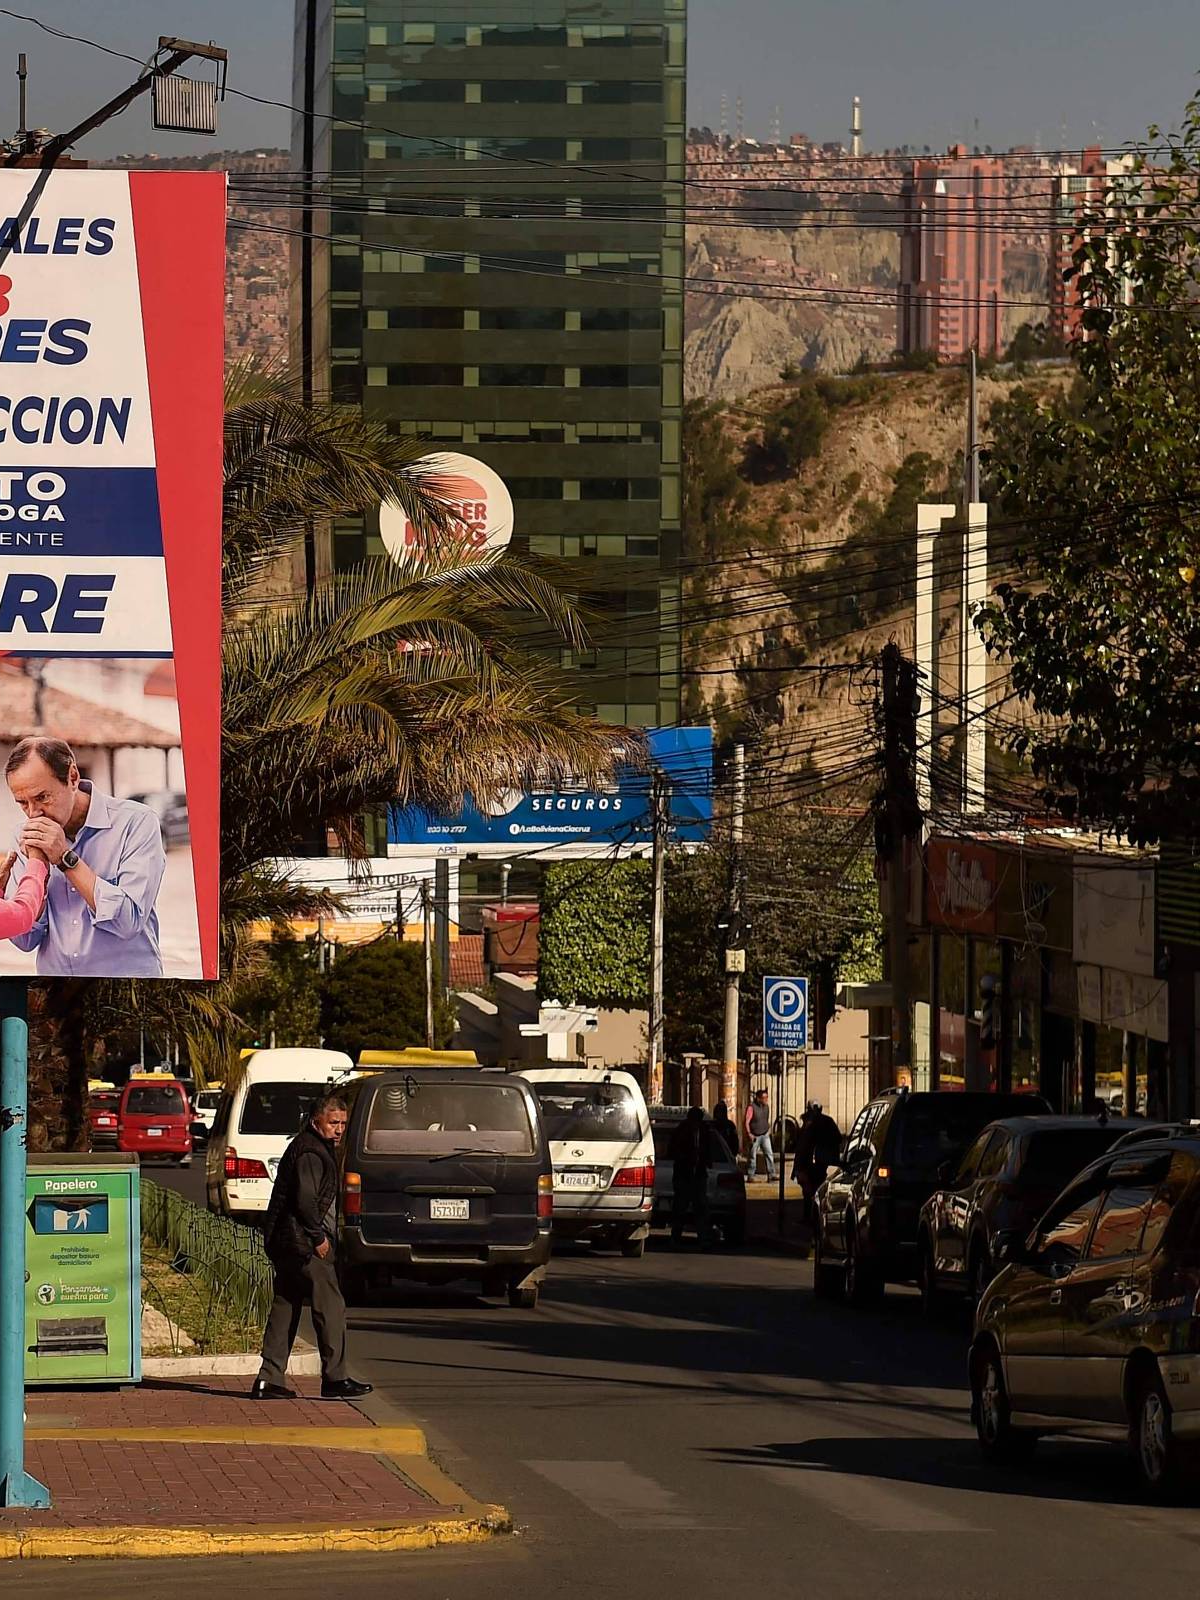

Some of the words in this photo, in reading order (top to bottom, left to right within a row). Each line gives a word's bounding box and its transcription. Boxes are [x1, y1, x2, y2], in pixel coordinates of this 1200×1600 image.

[532, 798, 622, 811] SEGUROS
[768, 1031, 803, 1039] TRANSPORTE
[45, 1178, 98, 1192] Papelero
